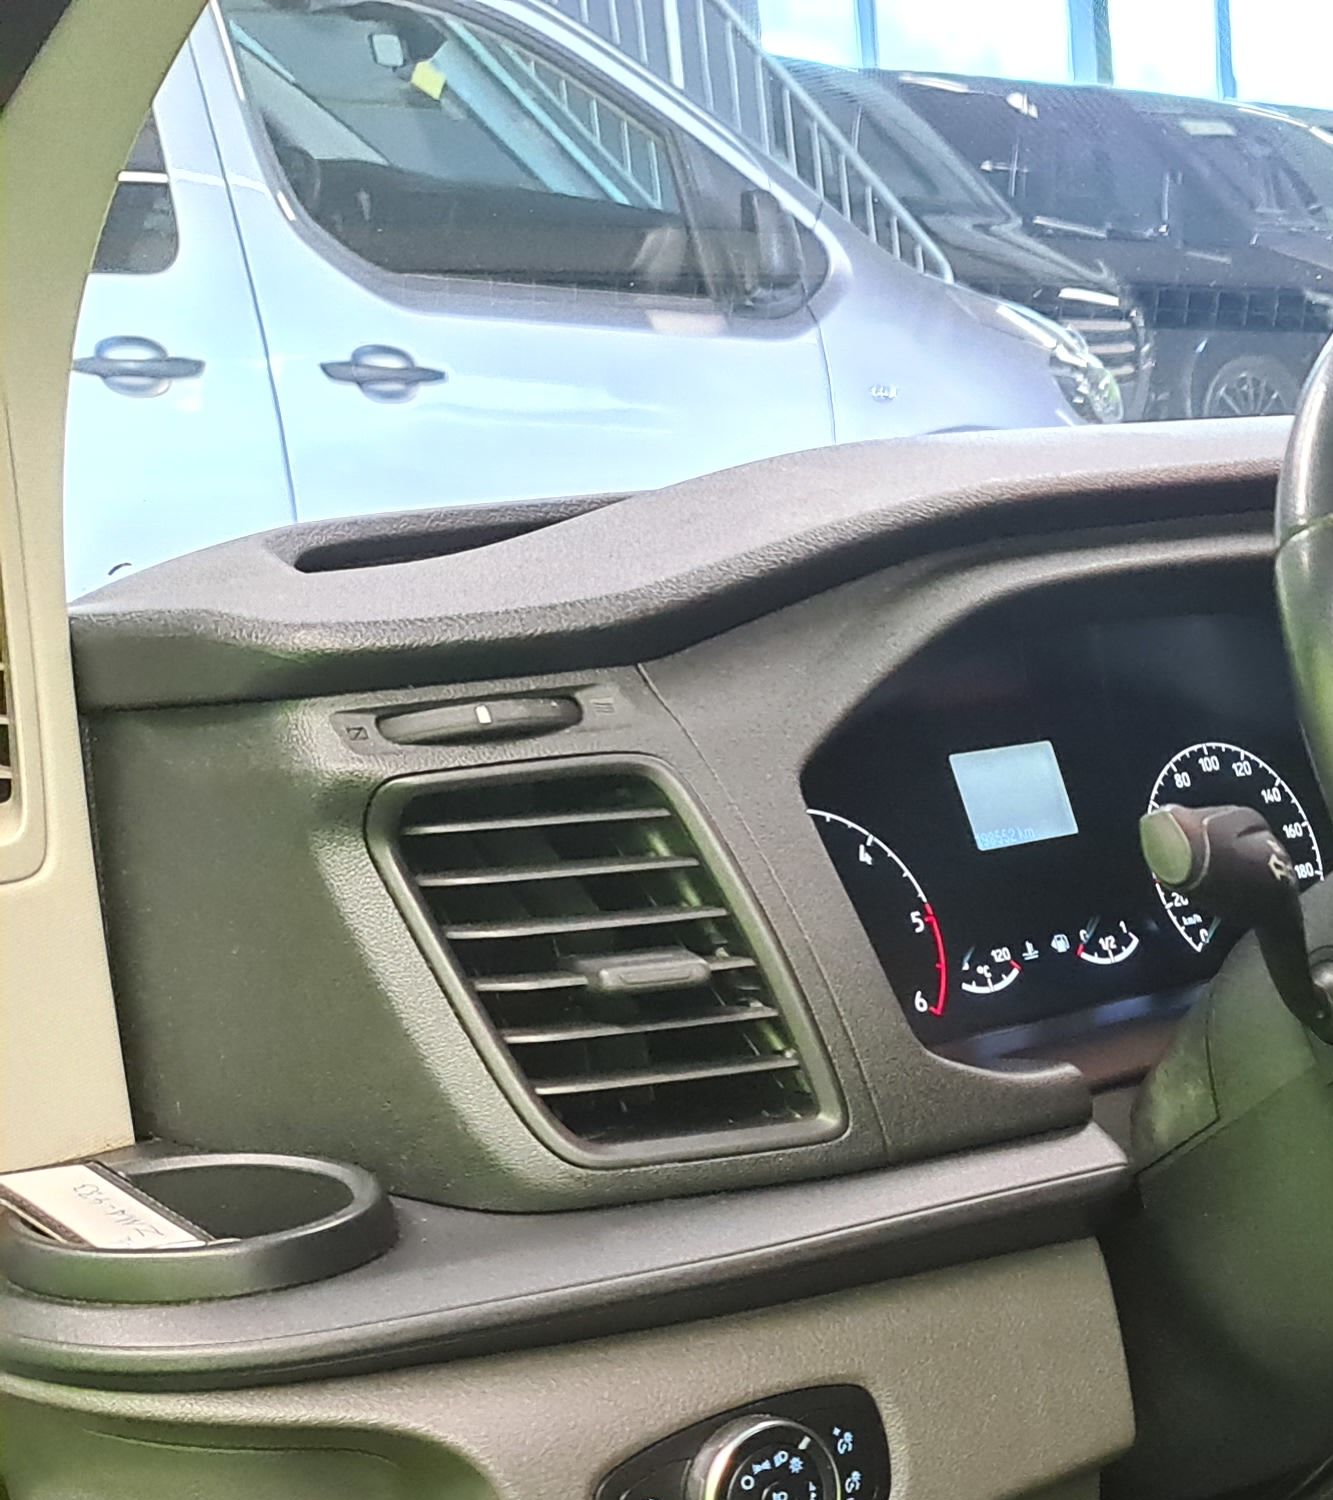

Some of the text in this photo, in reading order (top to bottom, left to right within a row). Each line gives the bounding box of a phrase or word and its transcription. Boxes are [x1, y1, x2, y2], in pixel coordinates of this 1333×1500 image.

[1198, 755, 1220, 772] 100
[1232, 761, 1252, 777] 120
[1174, 772, 1191, 788] 80
[1261, 787, 1282, 804] 140
[1283, 823, 1303, 839] 160
[859, 844, 873, 866] 4
[1294, 862, 1314, 879] 180
[910, 911, 925, 933] 5
[991, 946, 1011, 962] 120
[914, 991, 928, 1012] 6
